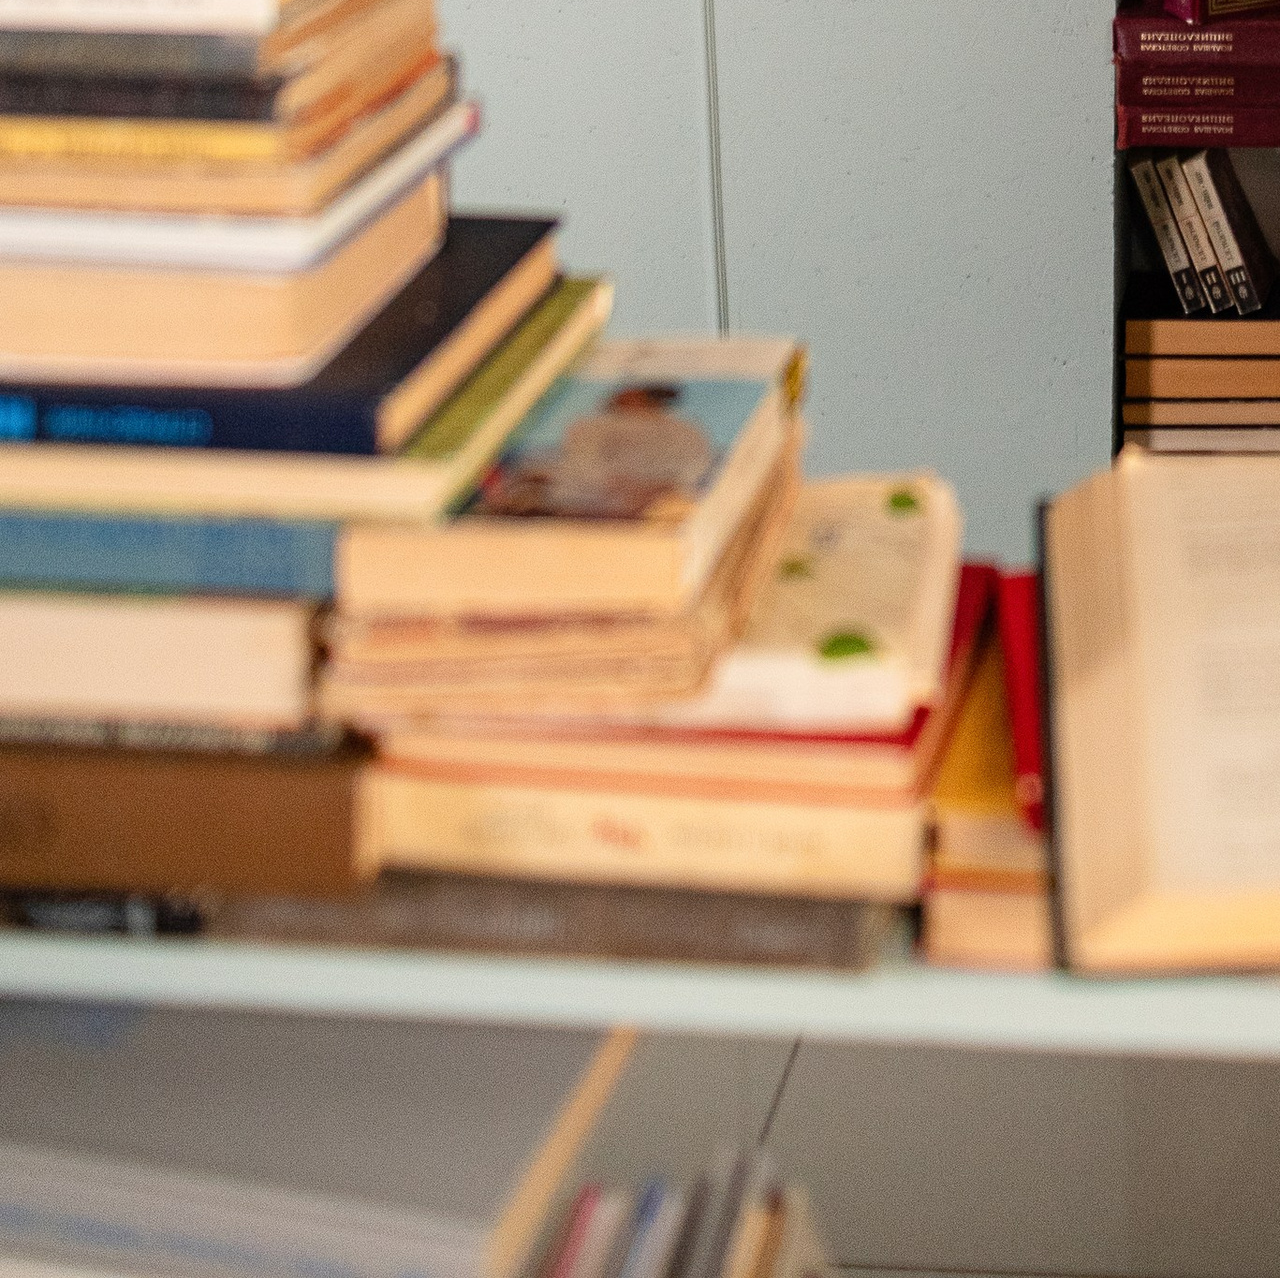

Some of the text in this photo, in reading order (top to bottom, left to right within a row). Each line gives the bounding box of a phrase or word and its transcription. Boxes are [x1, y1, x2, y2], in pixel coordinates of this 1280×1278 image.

[1140, 32, 1234, 42] ЭНЦИКЛОПЕДИЯ
[1142, 76, 1234, 86] ЭНЦИКЛОПЕДИЯ
[1141, 115, 1234, 124] ЭНЦИКЛОПЕДИЯ
